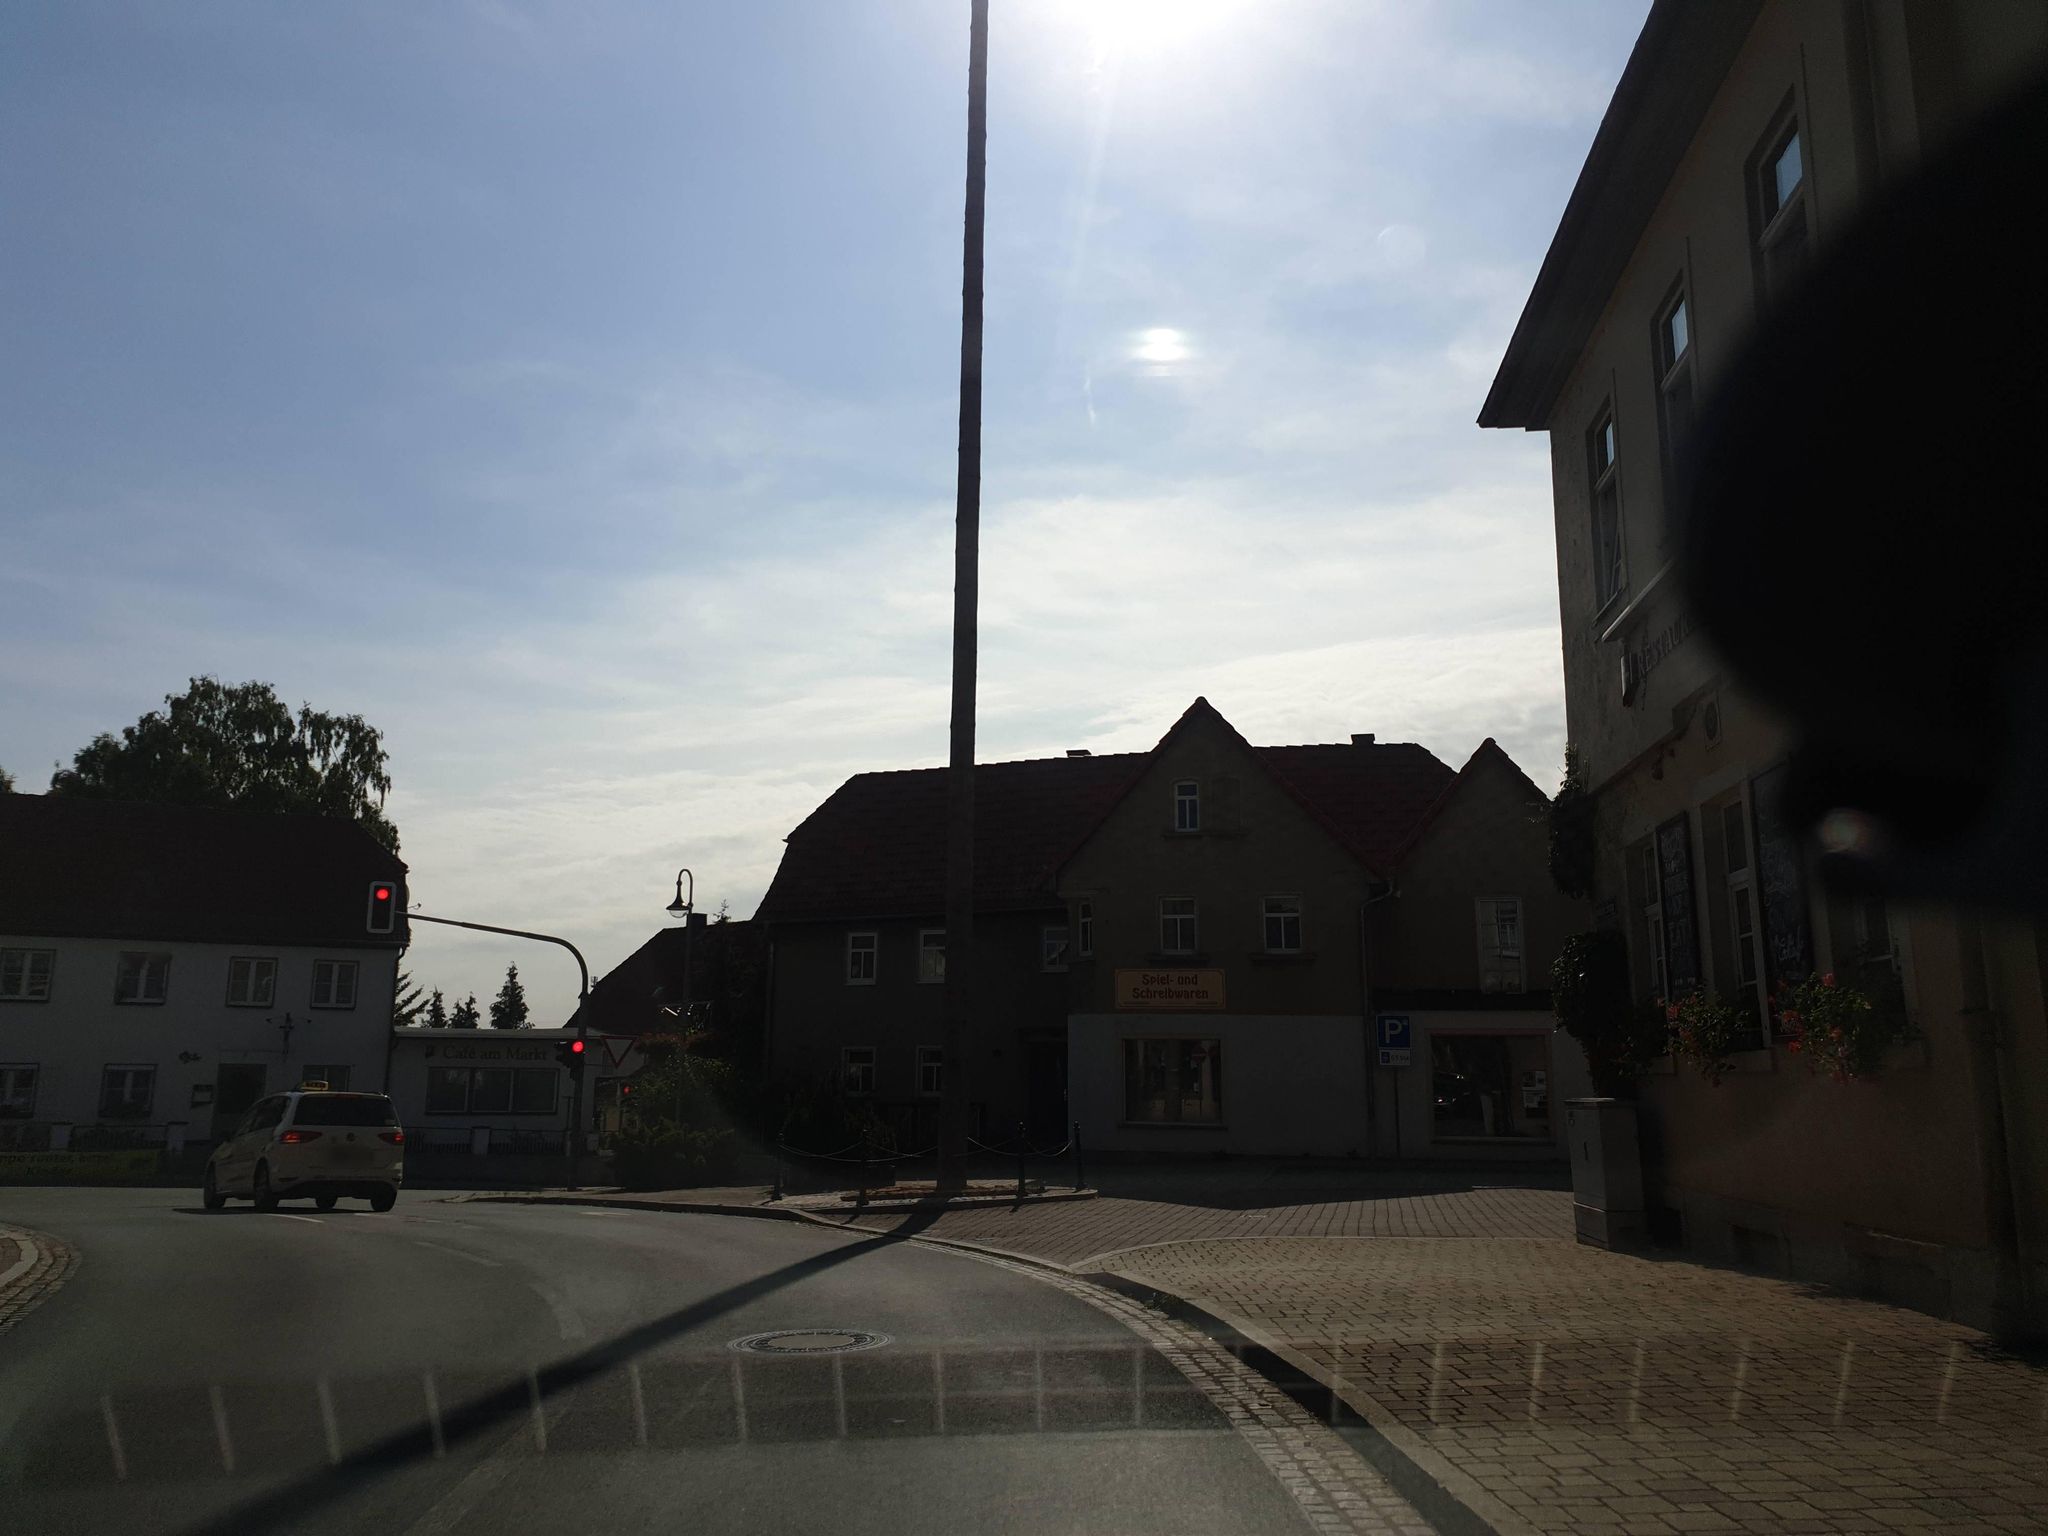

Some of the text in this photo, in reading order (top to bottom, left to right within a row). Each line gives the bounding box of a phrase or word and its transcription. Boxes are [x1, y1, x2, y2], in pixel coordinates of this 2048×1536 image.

[1142, 974, 1198, 985] Spiel- und
[1132, 987, 1209, 999] Schreibwaren
[1384, 1019, 1403, 1044] P
[480, 1050, 501, 1060] am
[505, 1046, 547, 1061] Markt
